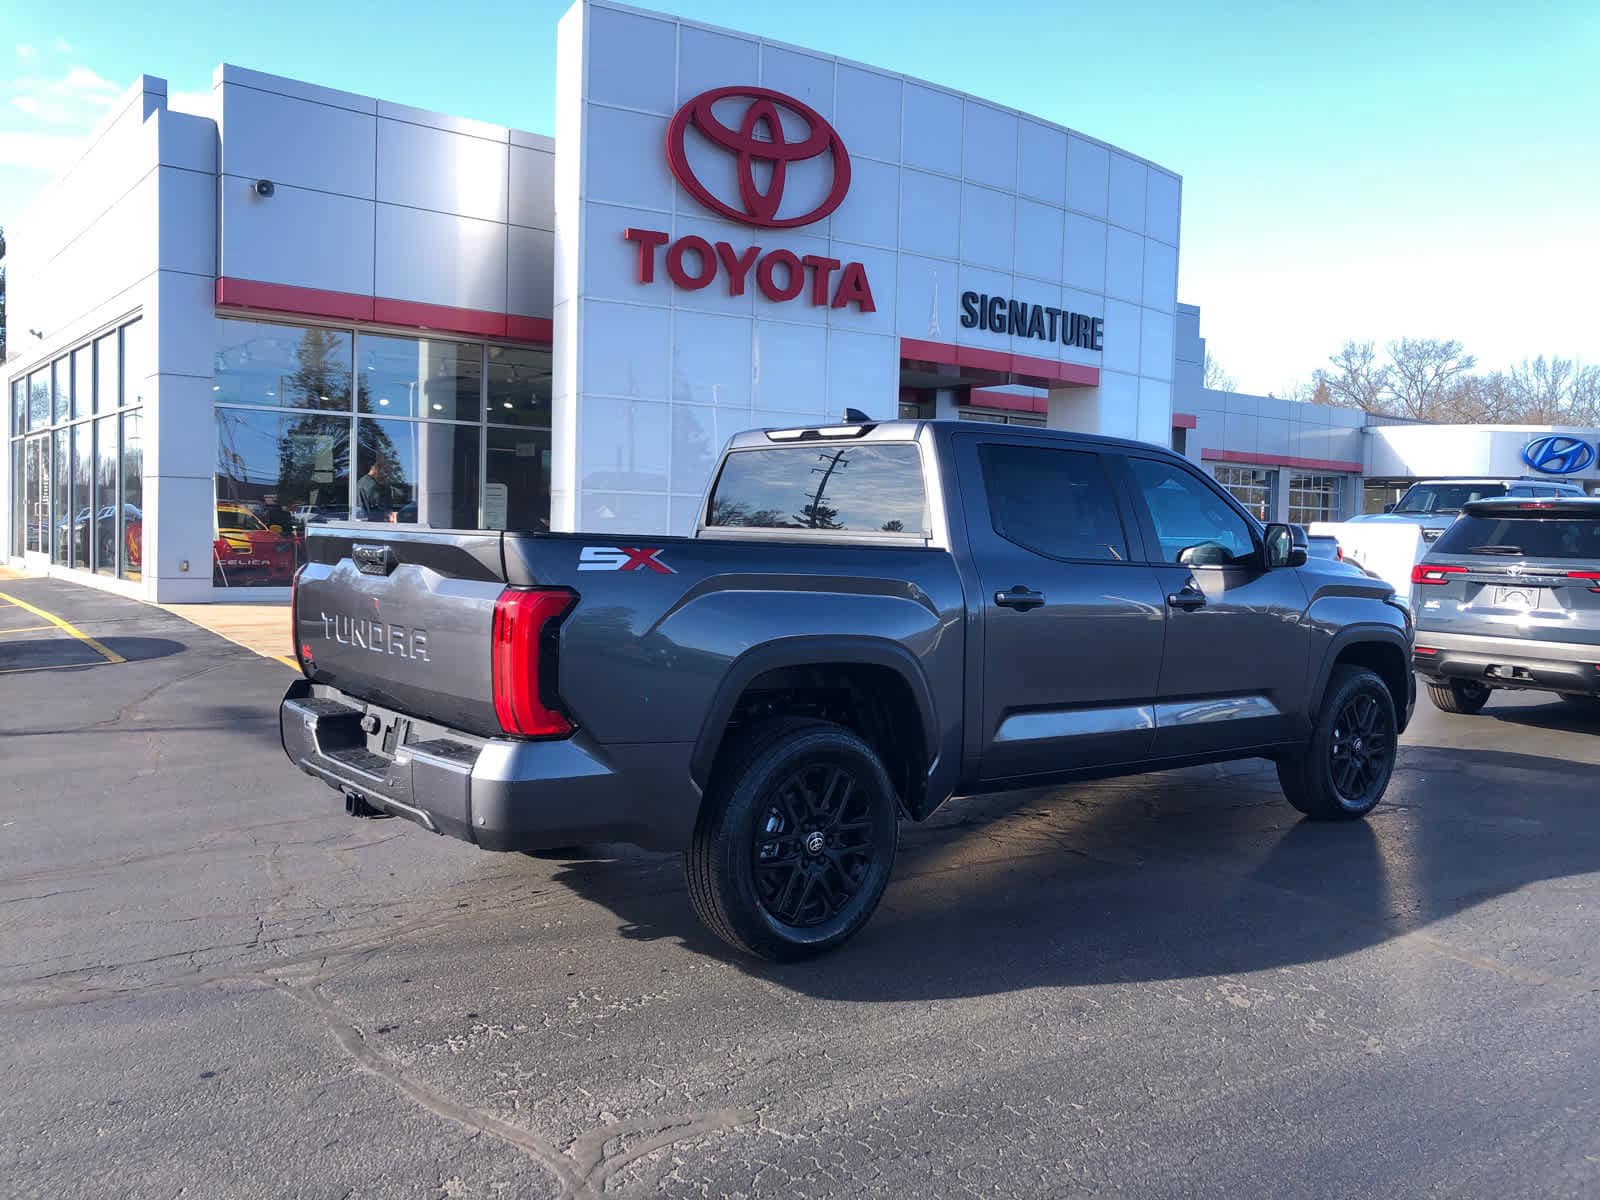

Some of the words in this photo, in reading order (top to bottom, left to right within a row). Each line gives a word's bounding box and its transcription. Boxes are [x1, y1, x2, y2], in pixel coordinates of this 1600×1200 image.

[624, 228, 876, 312] TOYOTA
[960, 291, 1104, 351] SIGNATURE
[321, 611, 430, 662] TUNDRA
